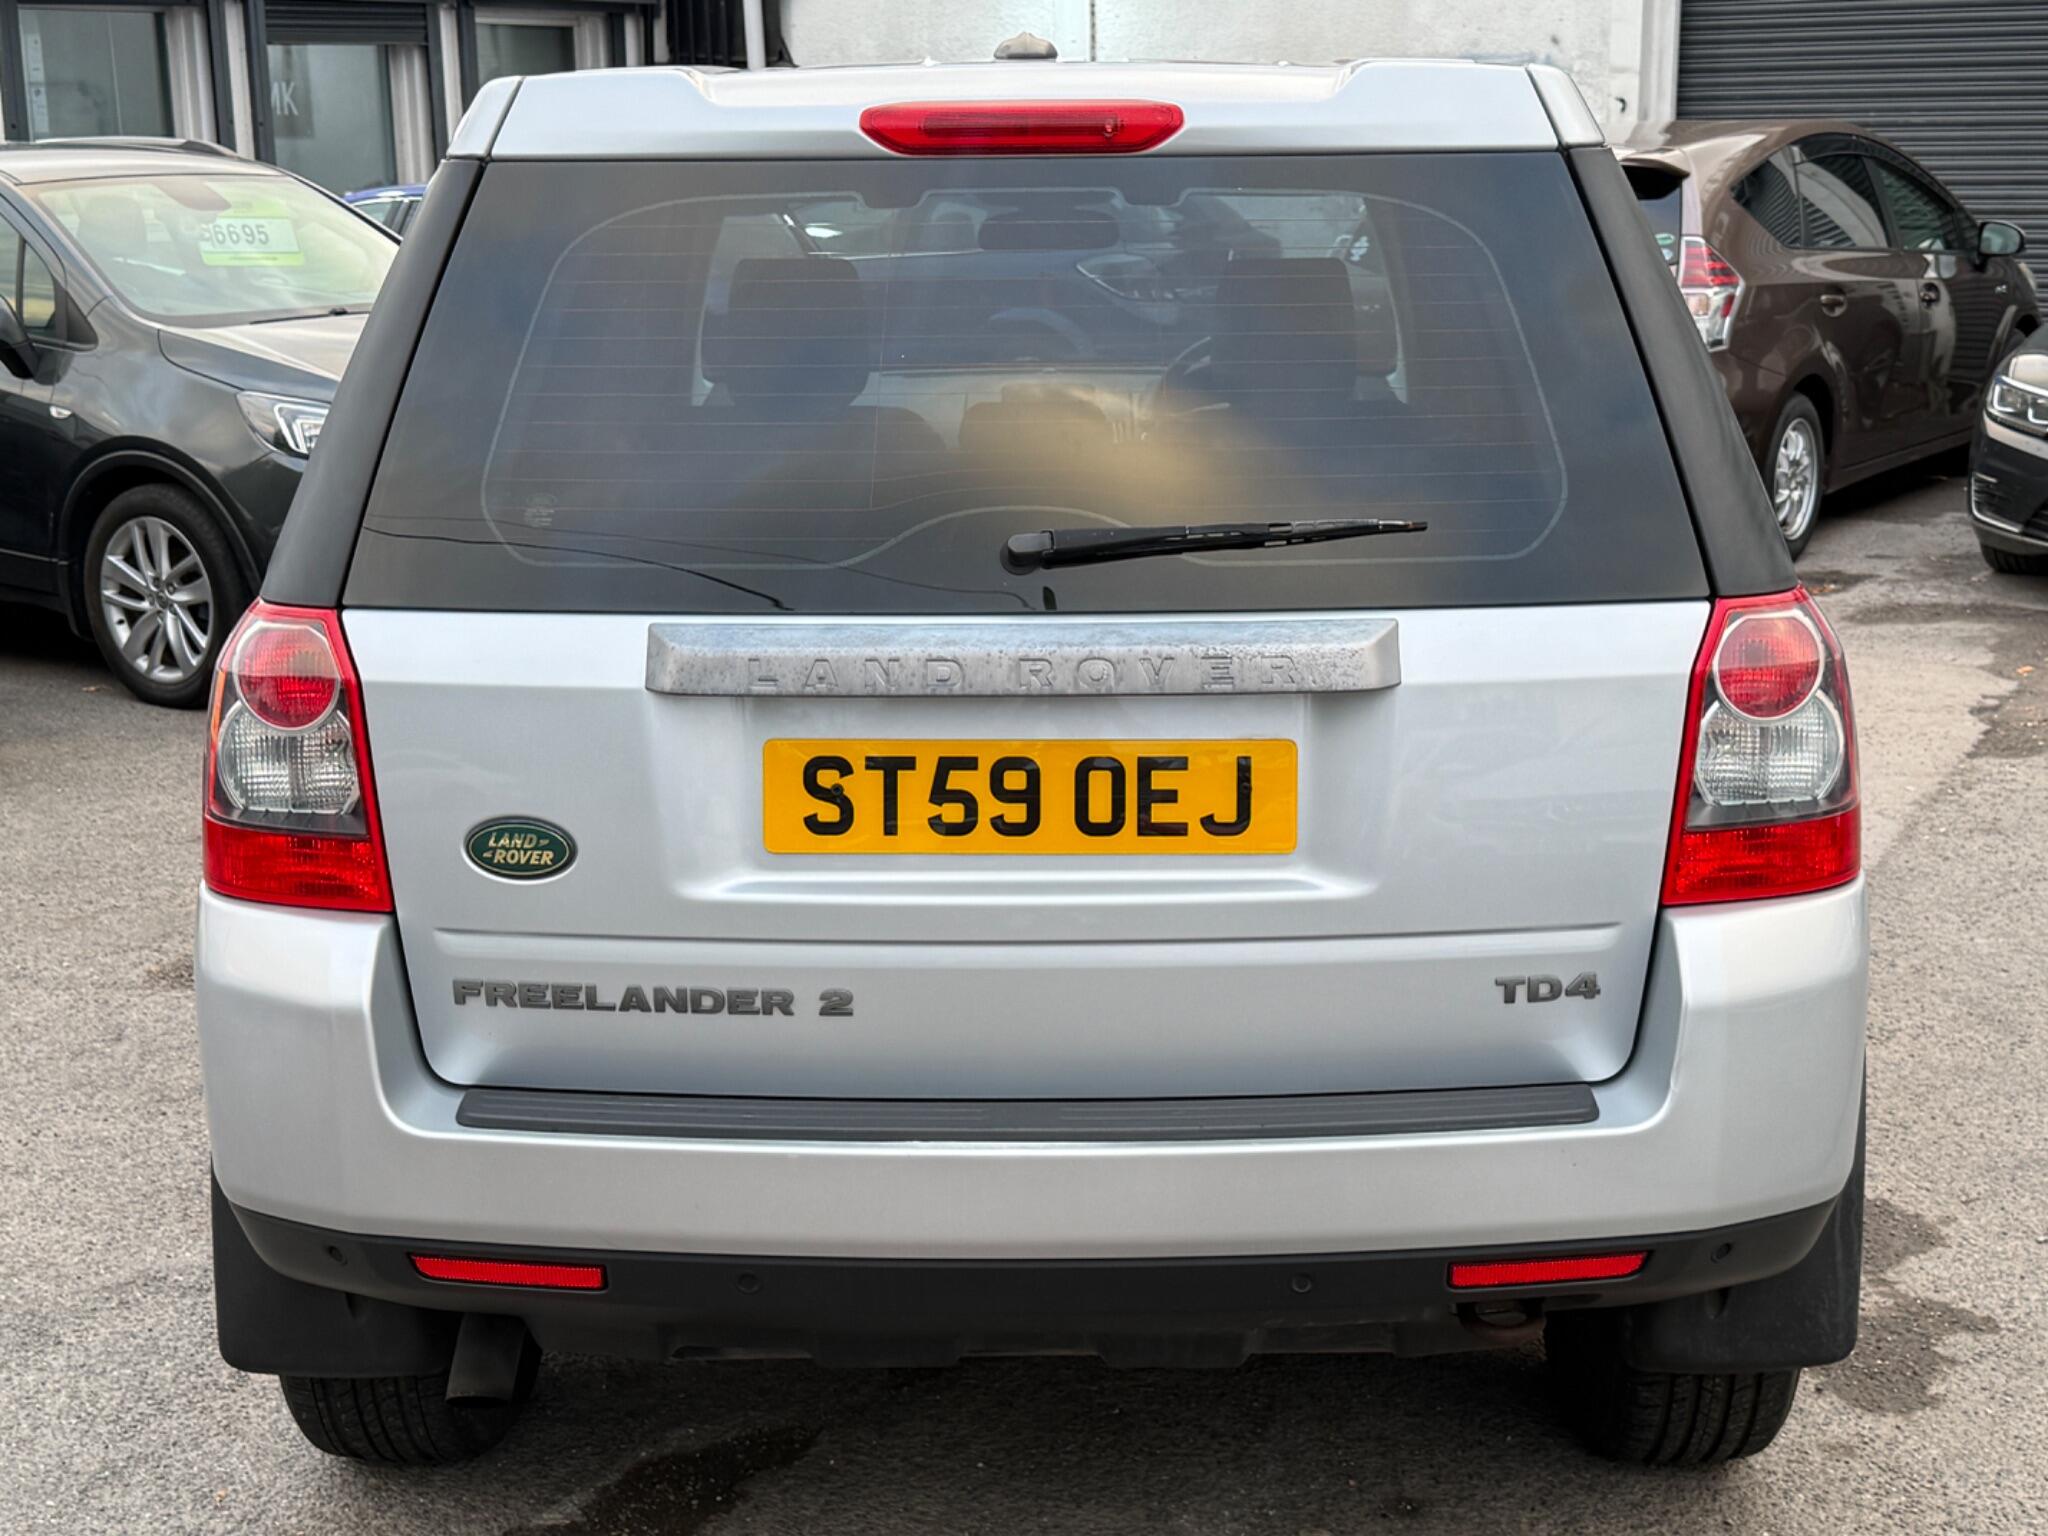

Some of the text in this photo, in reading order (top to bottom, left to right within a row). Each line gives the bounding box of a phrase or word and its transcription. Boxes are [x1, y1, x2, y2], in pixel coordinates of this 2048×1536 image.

[748, 654, 1298, 689] LAND ROVER
[802, 754, 1253, 836] ST59 OEJ
[488, 832, 538, 848] LAND
[493, 849, 554, 865] ROVER
[452, 978, 855, 1016] FREELANDER 2
[1494, 972, 1601, 1004] TD4
